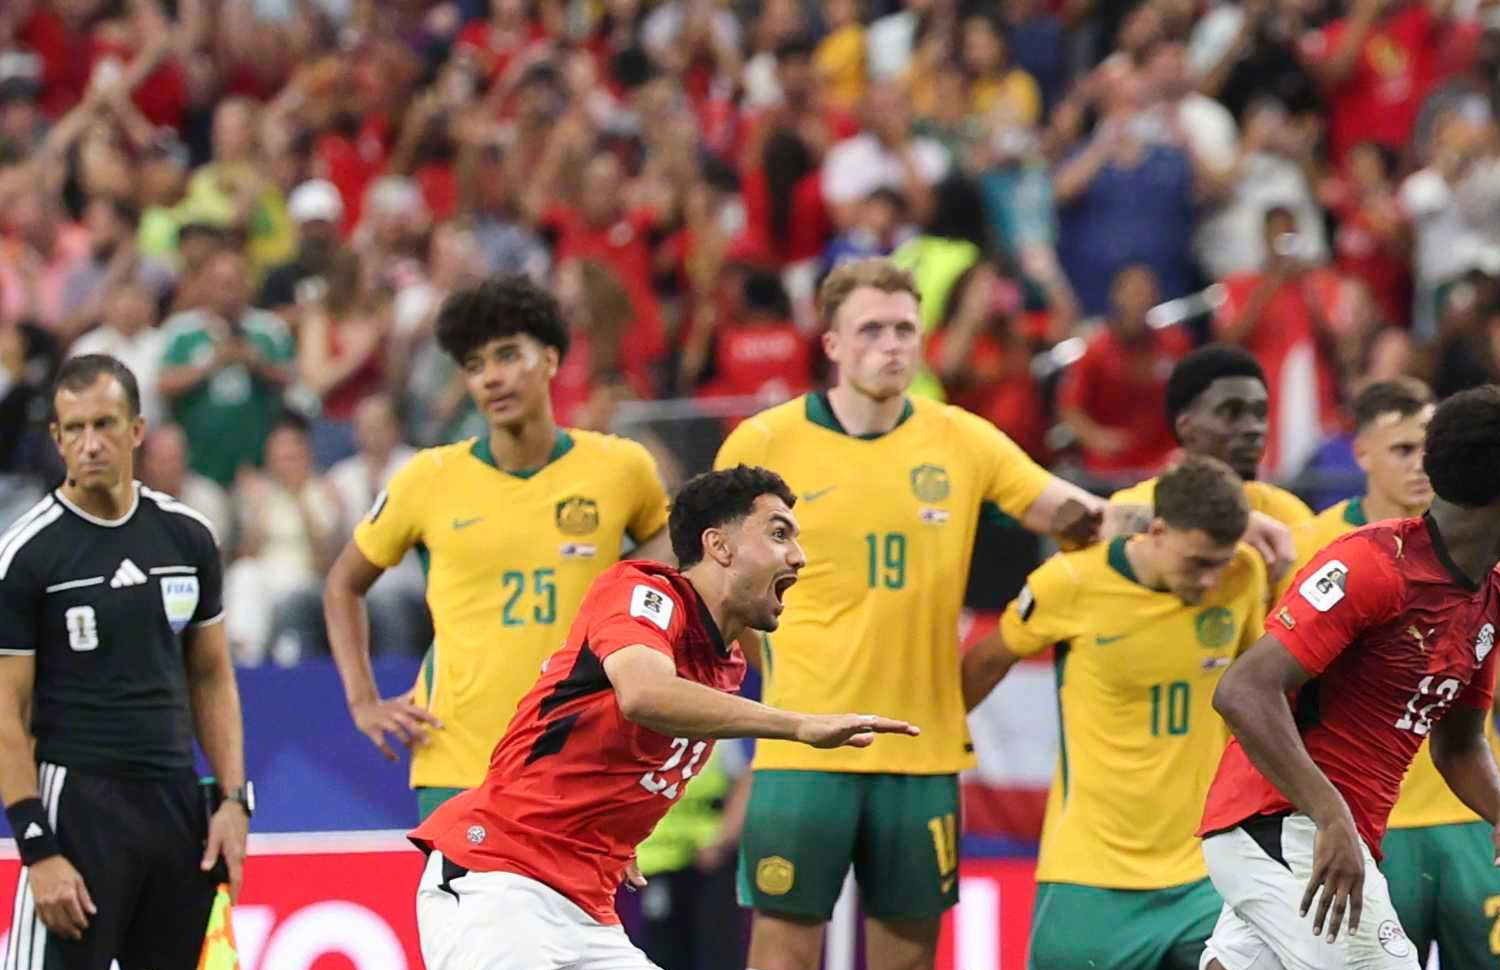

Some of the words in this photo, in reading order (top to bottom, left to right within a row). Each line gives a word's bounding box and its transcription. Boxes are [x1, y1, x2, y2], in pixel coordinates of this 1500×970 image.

[866, 532, 906, 590] 19
[502, 568, 557, 626] 25
[1151, 681, 1190, 737] 10
[1394, 675, 1461, 735] 12
